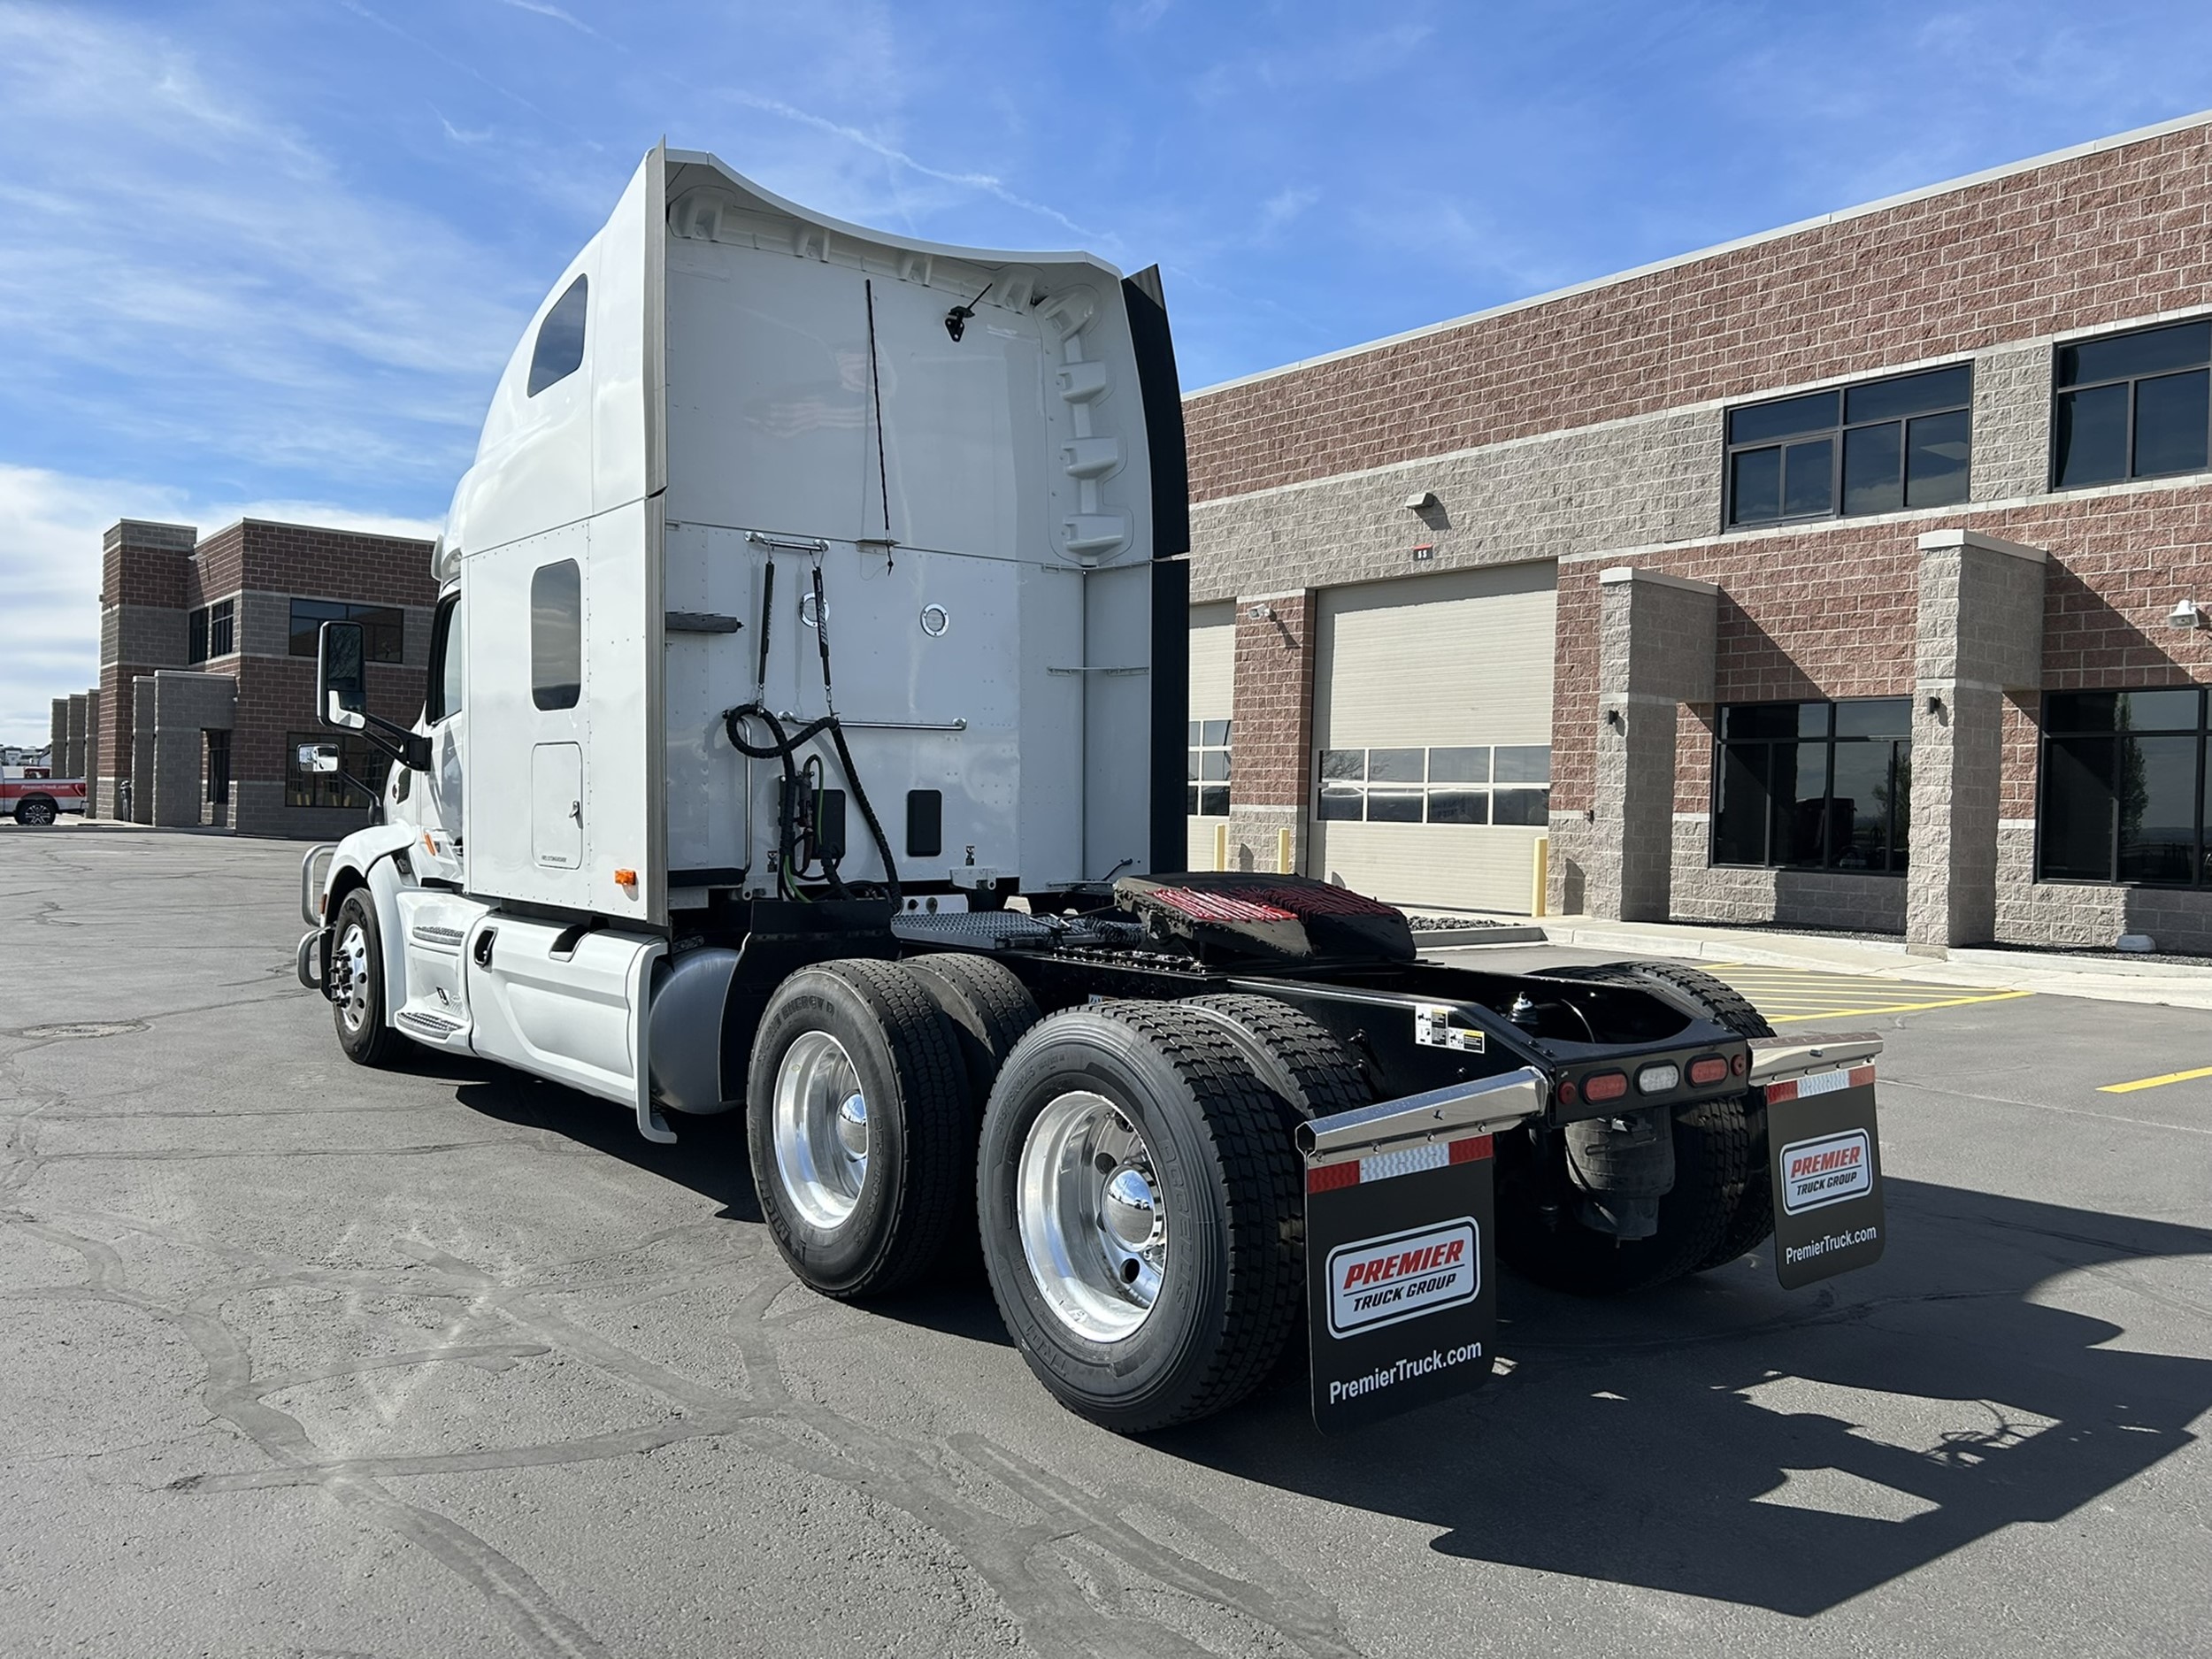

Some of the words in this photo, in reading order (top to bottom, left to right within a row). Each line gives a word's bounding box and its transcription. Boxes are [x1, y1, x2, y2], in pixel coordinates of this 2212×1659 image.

[781, 995, 825, 1020] ENERGY
[1790, 1146, 1861, 1179] PREMIER
[1796, 1178, 1825, 1196] TRUCK
[1827, 1171, 1857, 1189] GROUP
[1343, 1239, 1465, 1289] PREMIER
[1786, 1225, 1877, 1264] PremierTruck.com
[1353, 1286, 1403, 1312] TRUCK
[1406, 1272, 1457, 1299] GROUP
[1329, 1341, 1482, 1404] PremierTruck.com
